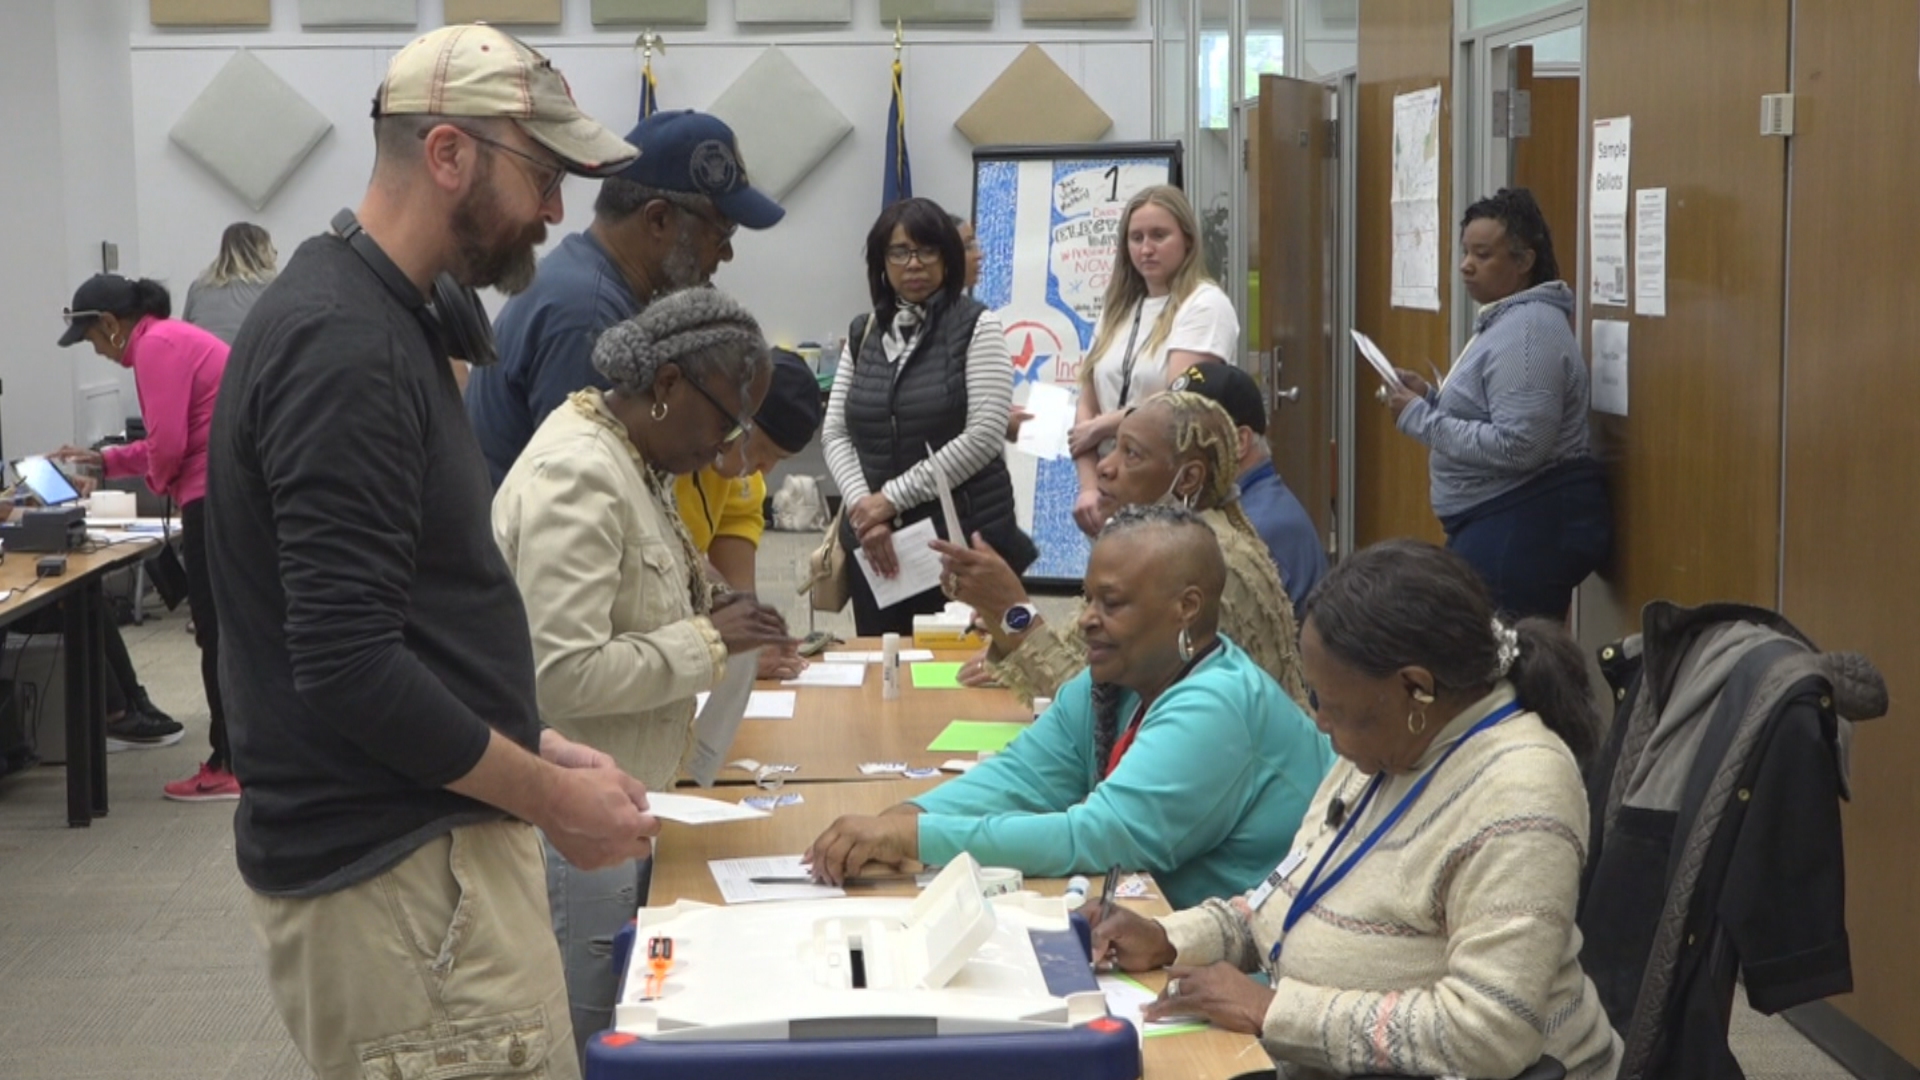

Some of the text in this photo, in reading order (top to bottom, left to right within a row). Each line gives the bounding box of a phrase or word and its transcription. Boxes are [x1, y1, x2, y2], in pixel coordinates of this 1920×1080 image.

[1598, 140, 1627, 162] Sample
[1104, 165, 1118, 202] 1
[1596, 171, 1623, 192] Ballots
